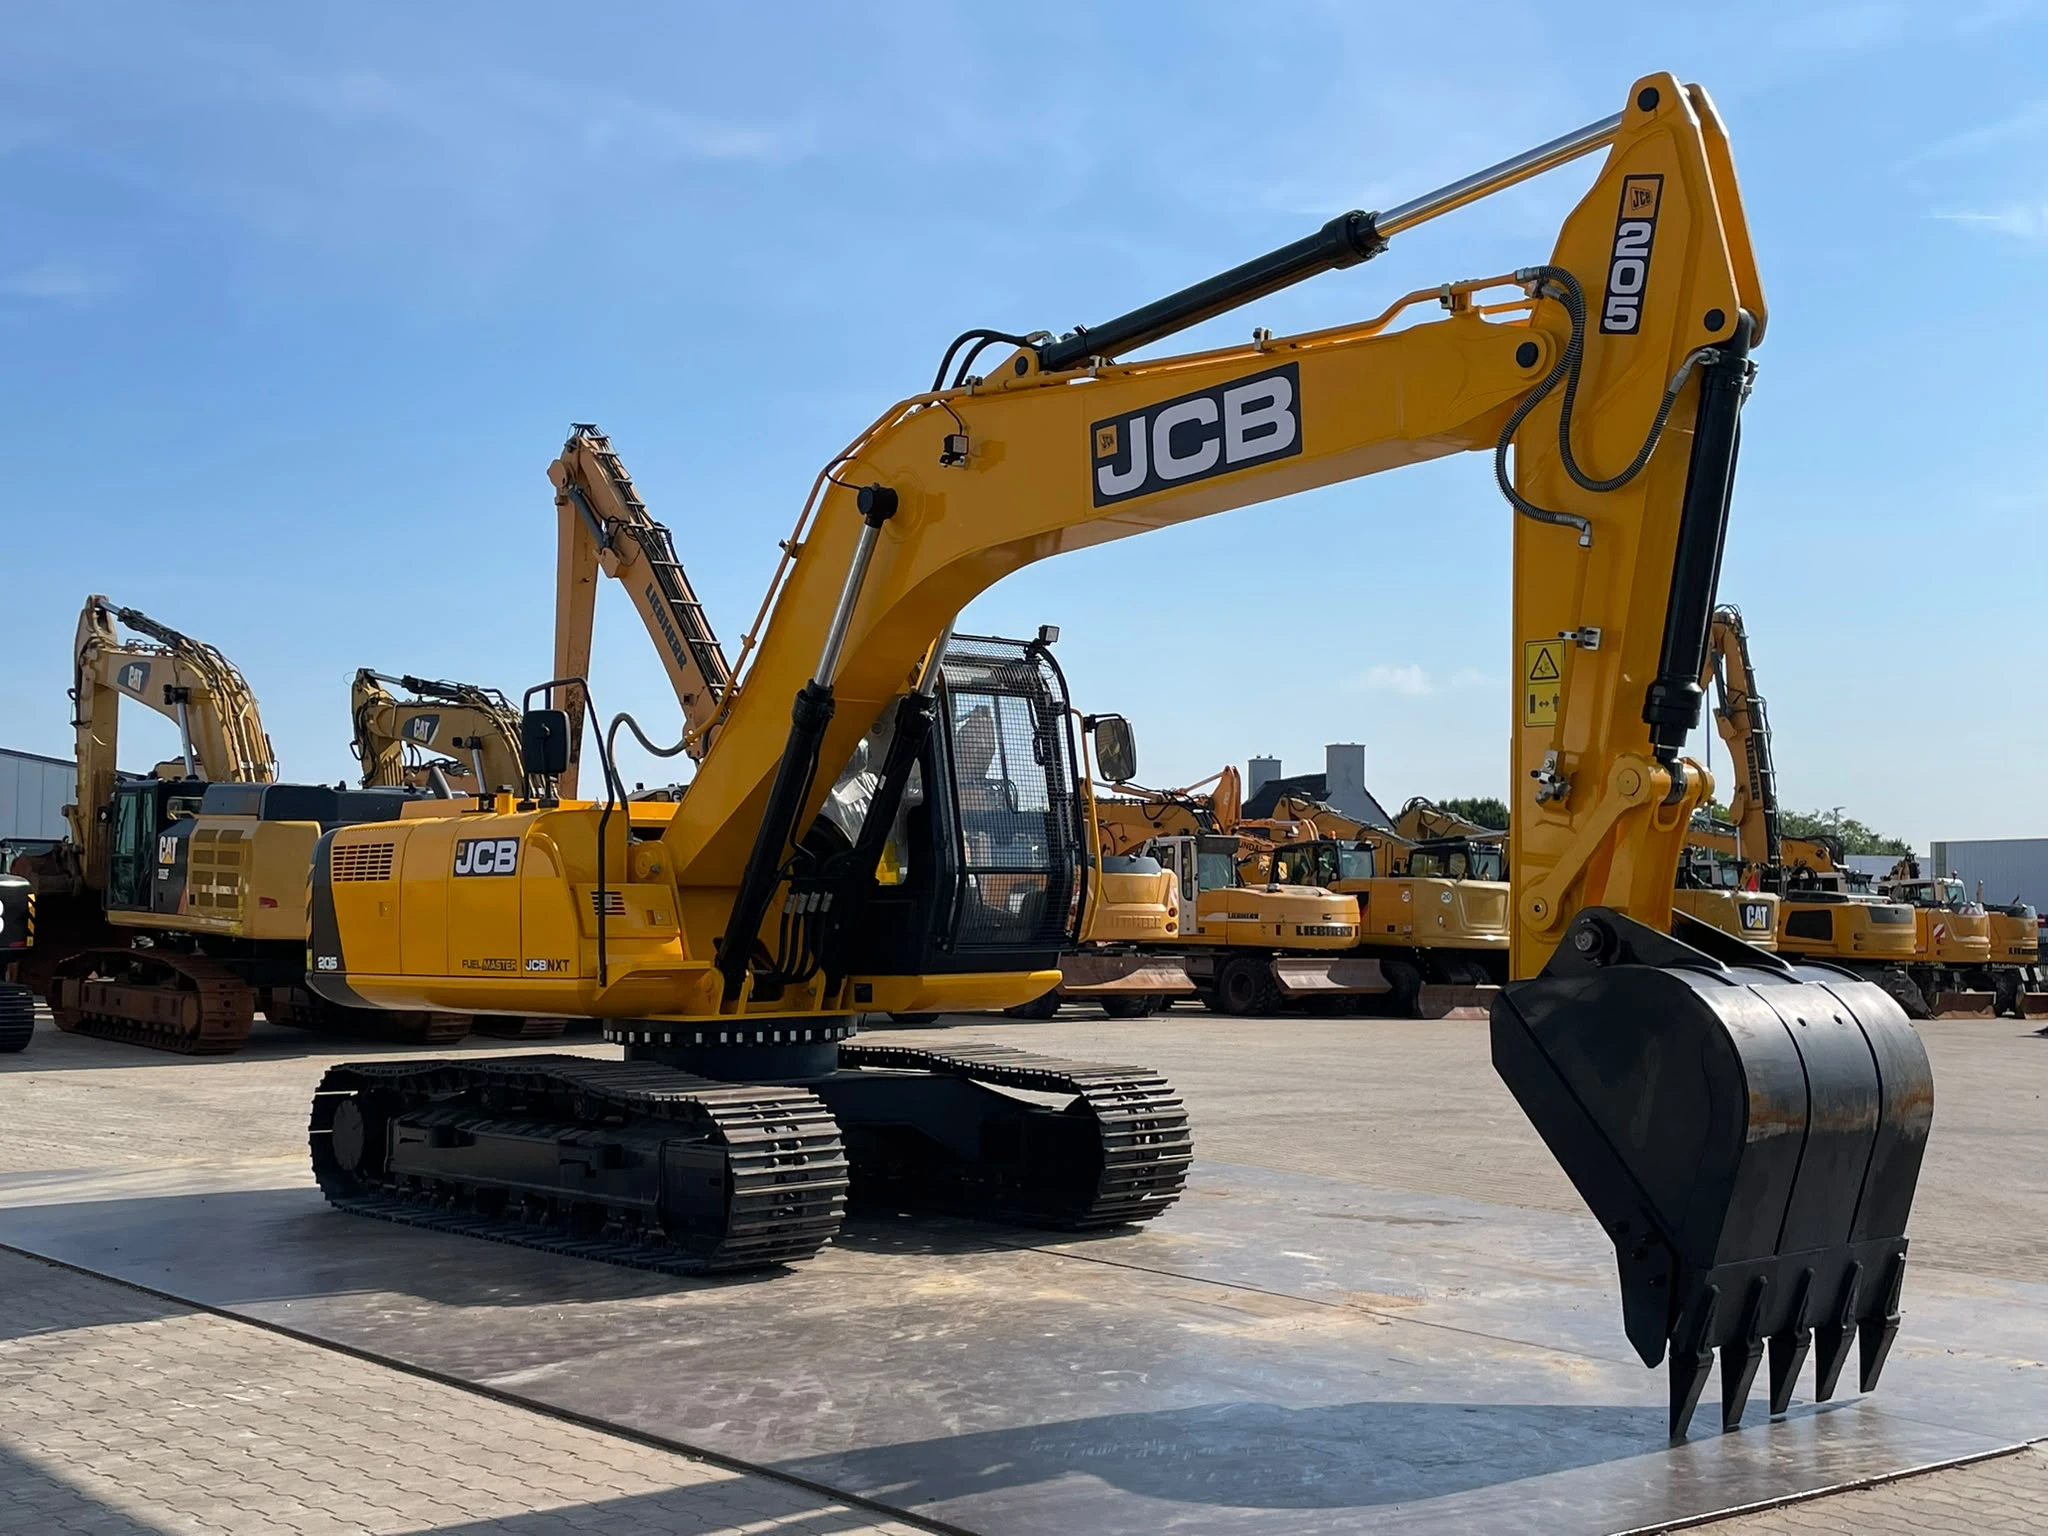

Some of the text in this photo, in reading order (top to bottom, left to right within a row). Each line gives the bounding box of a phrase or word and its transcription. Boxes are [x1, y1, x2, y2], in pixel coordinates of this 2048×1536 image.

[1632, 189, 1652, 208] JCB
[1604, 221, 1652, 331] 205
[1098, 376, 1296, 496] JCB
[128, 665, 143, 692] CAT
[413, 718, 430, 742] CAT
[159, 836, 178, 864] CAT
[455, 840, 517, 874] JCB
[1746, 905, 1768, 929] CAT
[317, 956, 338, 970] 205
[462, 959, 517, 971] FUEL MASTER
